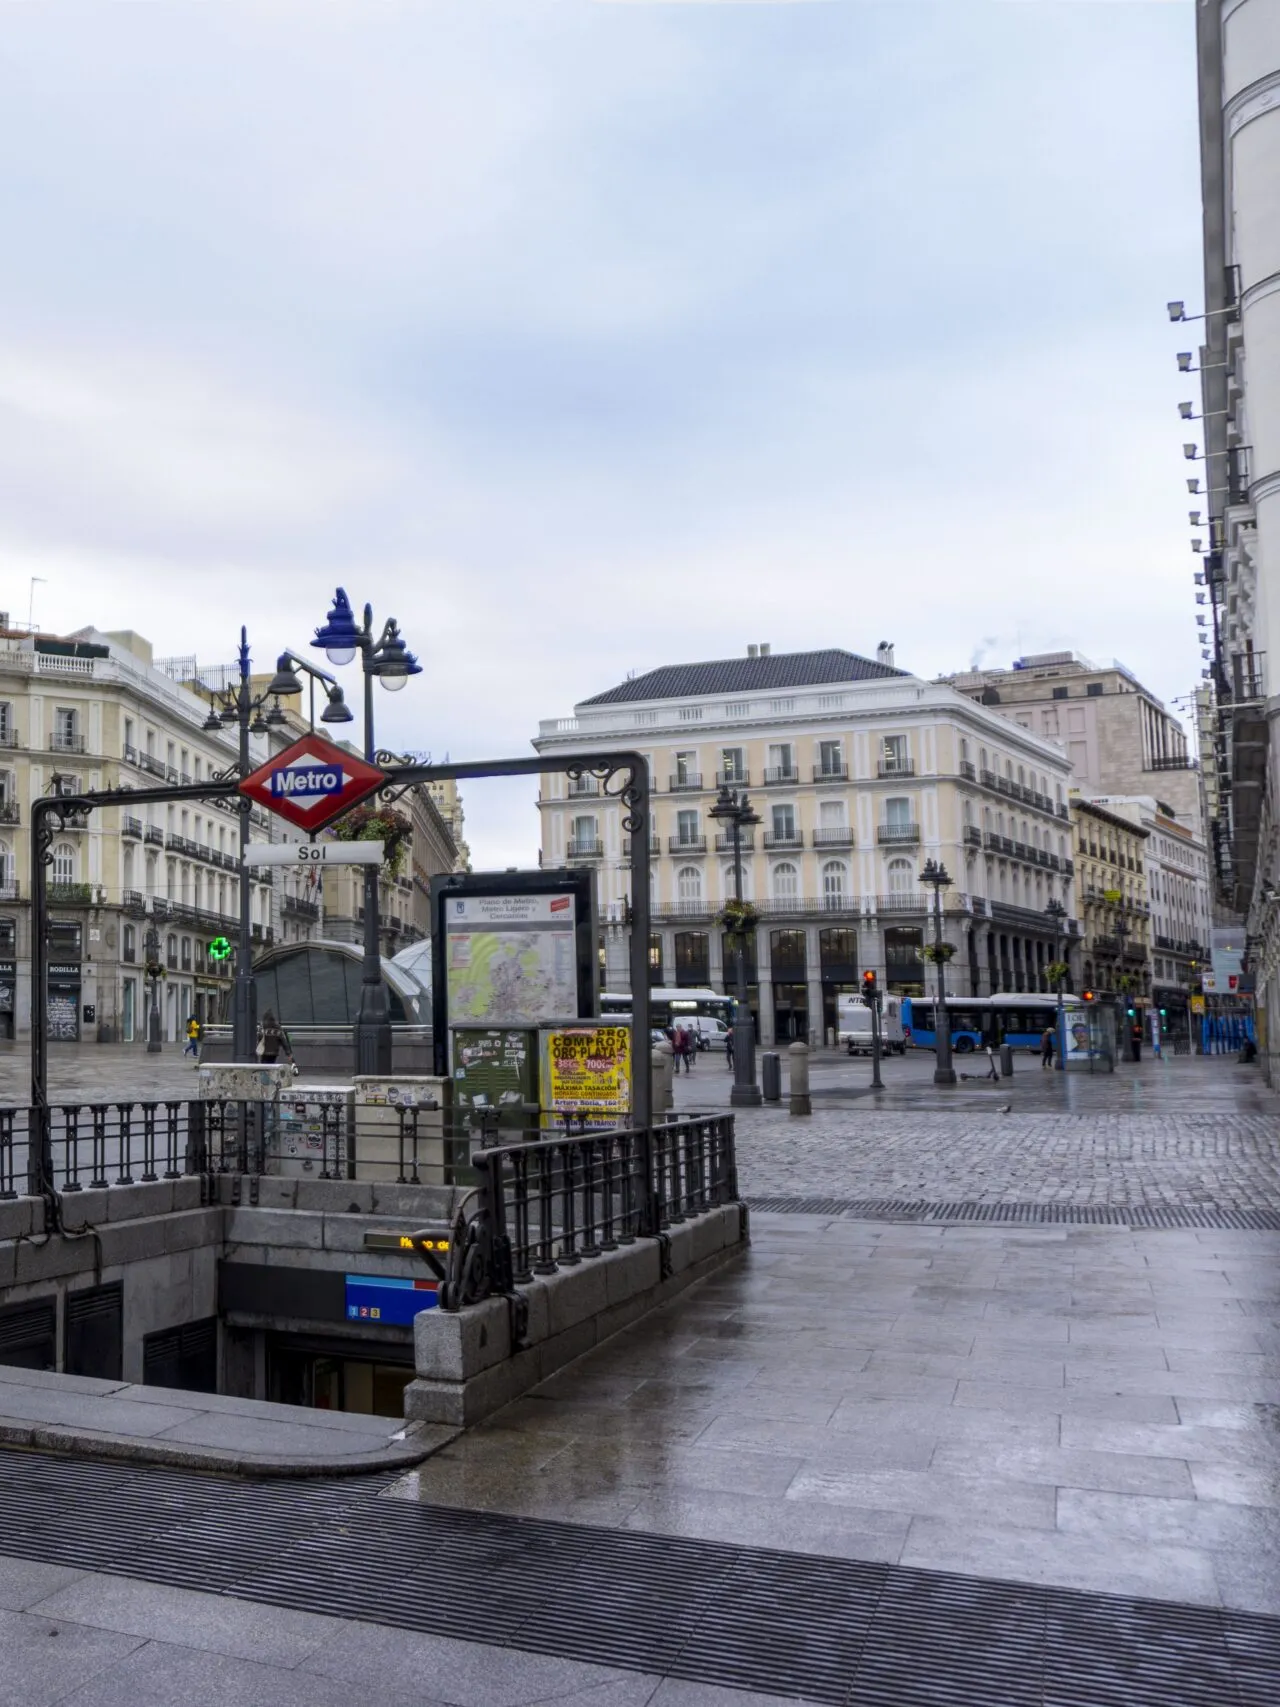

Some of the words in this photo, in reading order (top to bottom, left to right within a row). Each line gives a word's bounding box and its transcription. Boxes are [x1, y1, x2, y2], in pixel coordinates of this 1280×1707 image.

[276, 771, 337, 792] Metro
[298, 846, 327, 860] Sol
[553, 1037, 616, 1046] COMPRO
[361, 1308, 368, 1316] 2
[372, 1309, 379, 1317] 3
